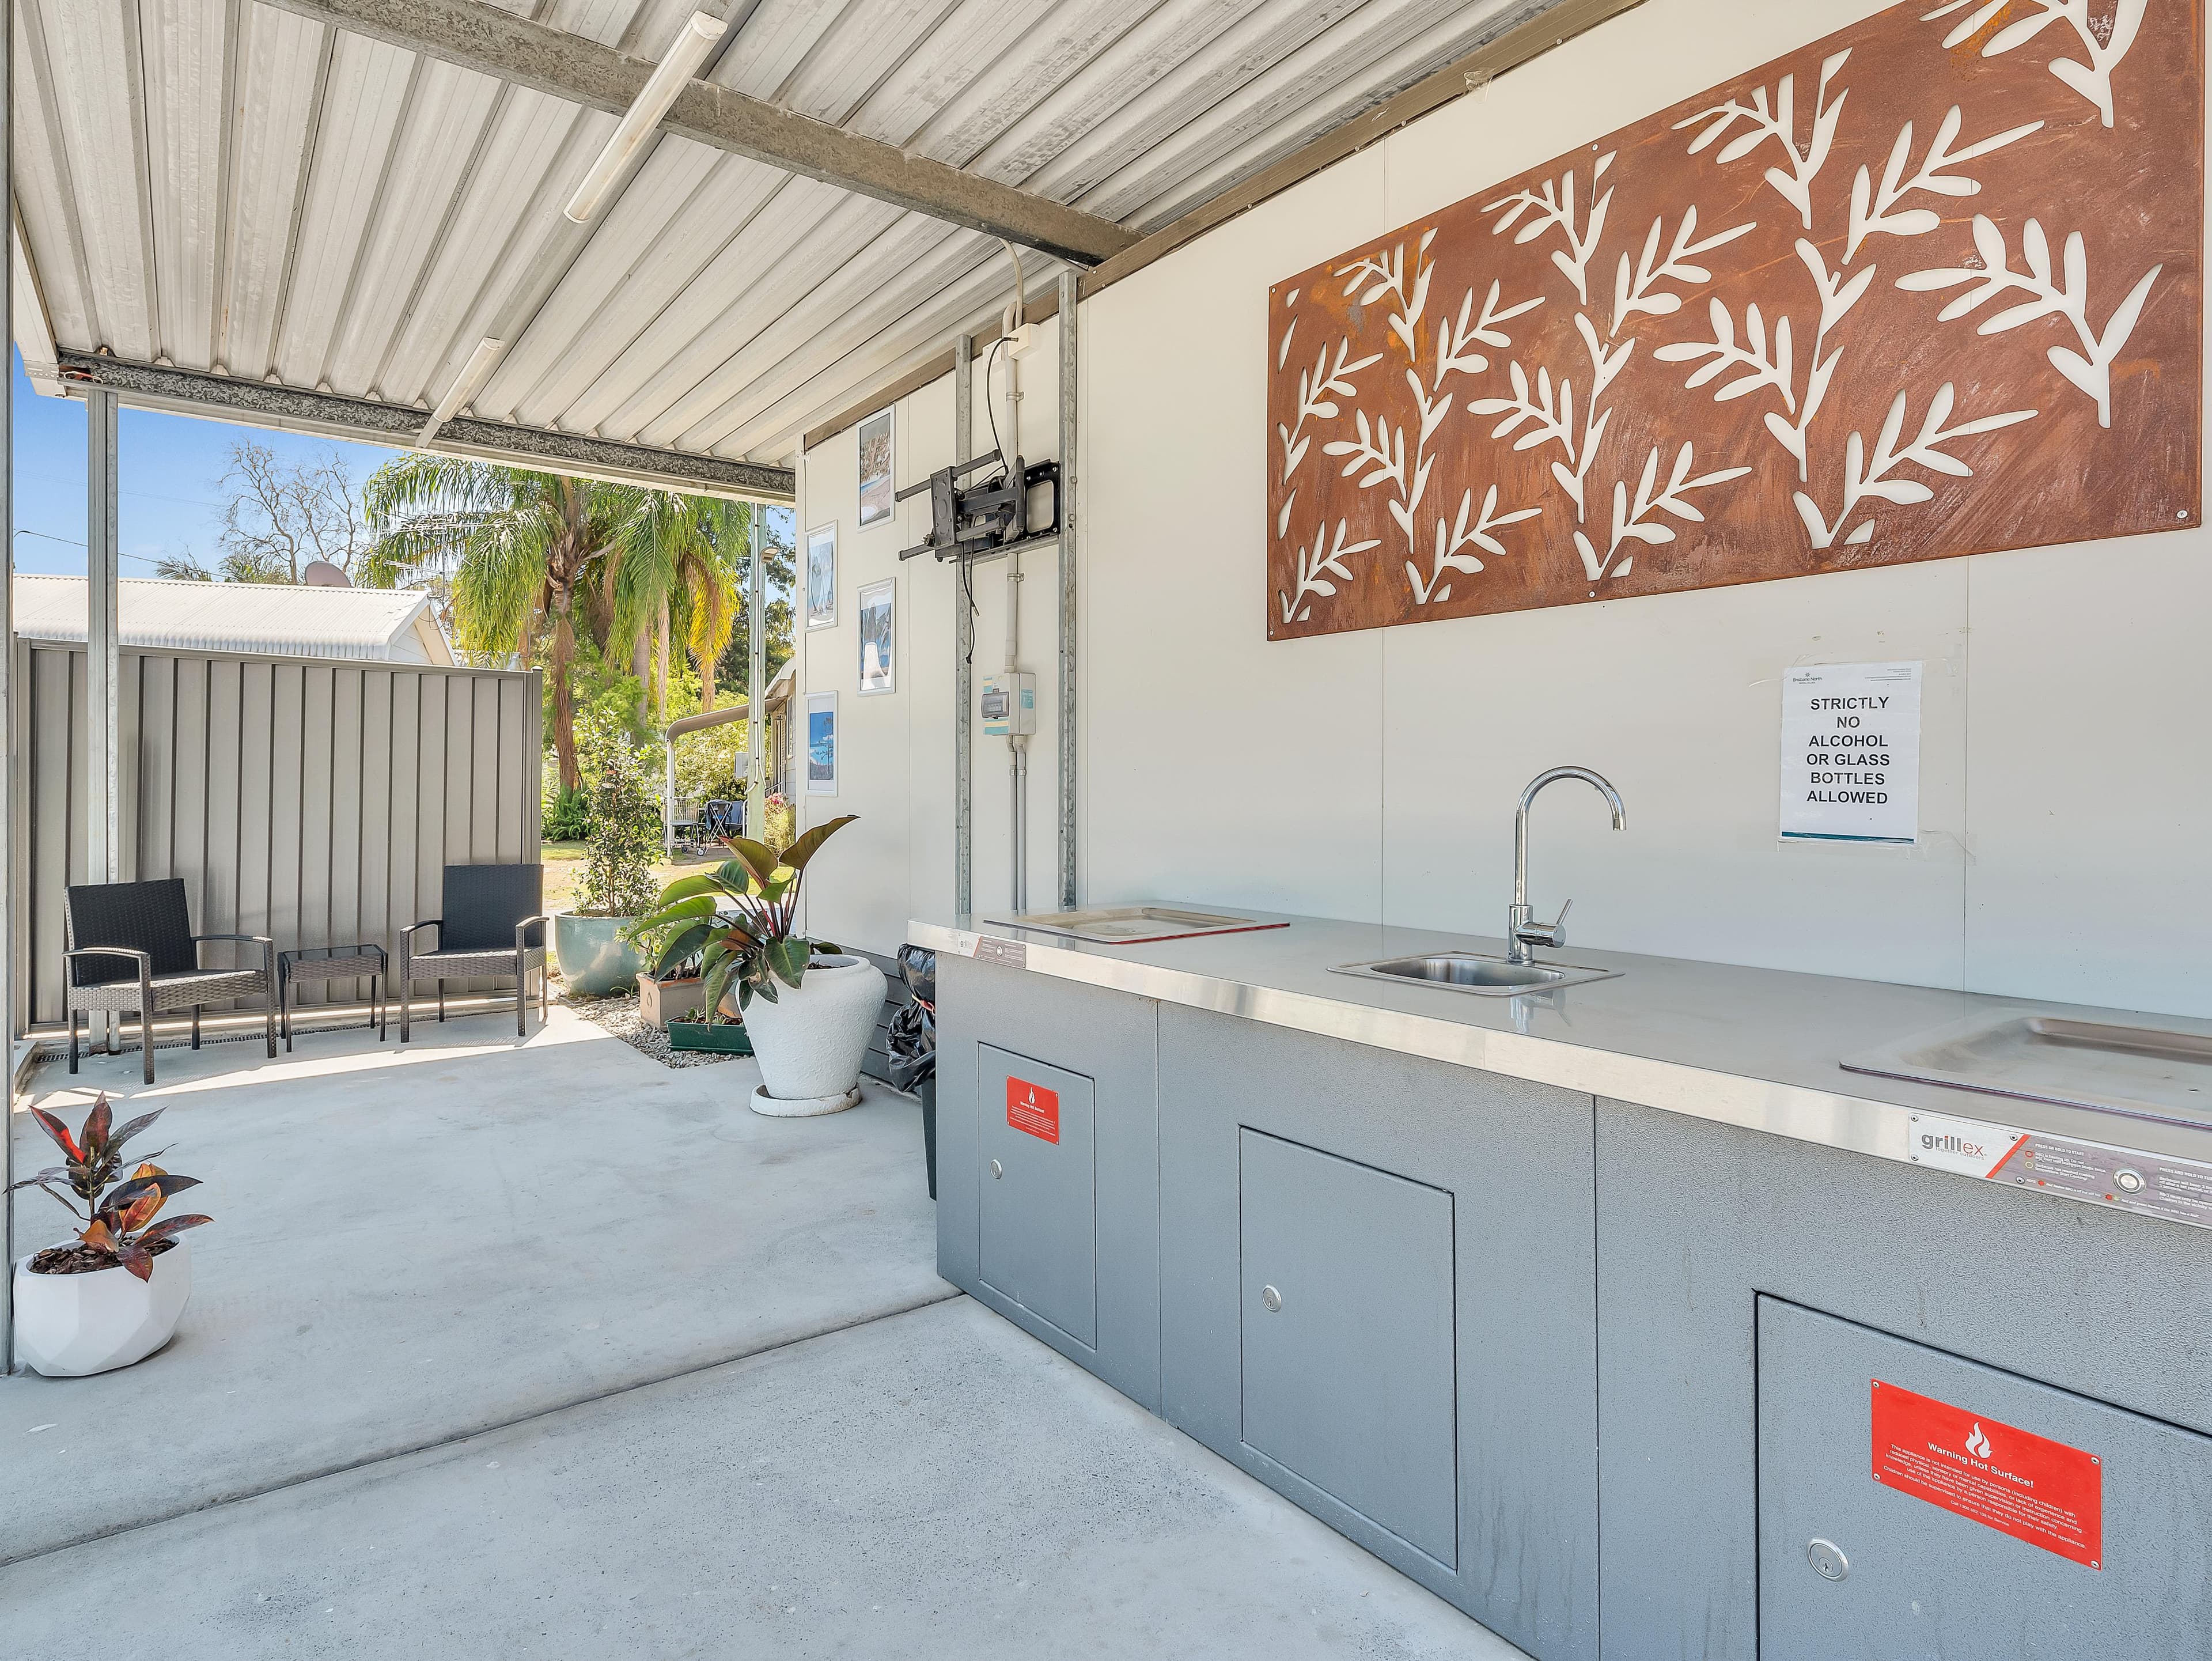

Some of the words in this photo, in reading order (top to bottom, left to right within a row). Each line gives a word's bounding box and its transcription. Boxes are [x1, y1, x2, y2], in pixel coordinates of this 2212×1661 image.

[1810, 697, 1889, 710] STRICTLY
[1836, 716, 1861, 728] NO
[1808, 735, 1888, 747] ALCOHOL
[1806, 754, 1830, 765] OR
[1835, 754, 1890, 766] GLASS
[1810, 772, 1885, 785] BOTTLES
[1806, 790, 1888, 804] ALLOWED
[1922, 1134, 1984, 1157] grillex
[1960, 1152, 1984, 1160] outdoors
[1928, 1442, 1967, 1465] Warning
[1971, 1458, 1988, 1471] Hot
[1991, 1466, 2033, 1488] Surface!
[1890, 1450, 1909, 1460] reduced
[1932, 1466, 1951, 1477] sensory
[1959, 1475, 1976, 1486] mental
[2016, 1497, 2026, 1505] lack
[2035, 1505, 2065, 1521] experience
[2067, 1517, 2077, 1525] and
[1891, 1444, 1901, 1452] This
[1903, 1448, 1925, 1461] appliance
[1941, 1463, 1962, 1475] intended
[1990, 1482, 2010, 1494] persons
[2012, 1490, 2037, 1504] (including
[2039, 1500, 2062, 1514] children)
[2065, 1509, 2075, 1518] with
[1884, 1465, 1903, 1477] Children
[1904, 1473, 1920, 1484] should
[1929, 1483, 1955, 1498] supervised
[1963, 1497, 1980, 1507] ensure
[1981, 1504, 1991, 1512] that
[1992, 1508, 2003, 1517] they
[2023, 1520, 2034, 1530] play
[2036, 1526, 2046, 1534] with
[1914, 1464, 1929, 1474] unless
[1931, 1470, 1941, 1479] they
[1942, 1475, 1954, 1484] have
[1956, 1480, 1968, 1489] been
[1969, 1485, 1983, 1496] given
[1984, 1492, 2014, 1508] supervision
[2022, 1506, 2050, 1520] instruction
[2051, 1517, 2082, 1534] concerning
[1932, 1477, 1955, 1490] appliance
[1969, 1492, 1986, 1503] person
[1988, 1499, 2017, 1515] responsible
[2027, 1514, 2039, 1523] their
[1994, 1517, 2009, 1527] Service
